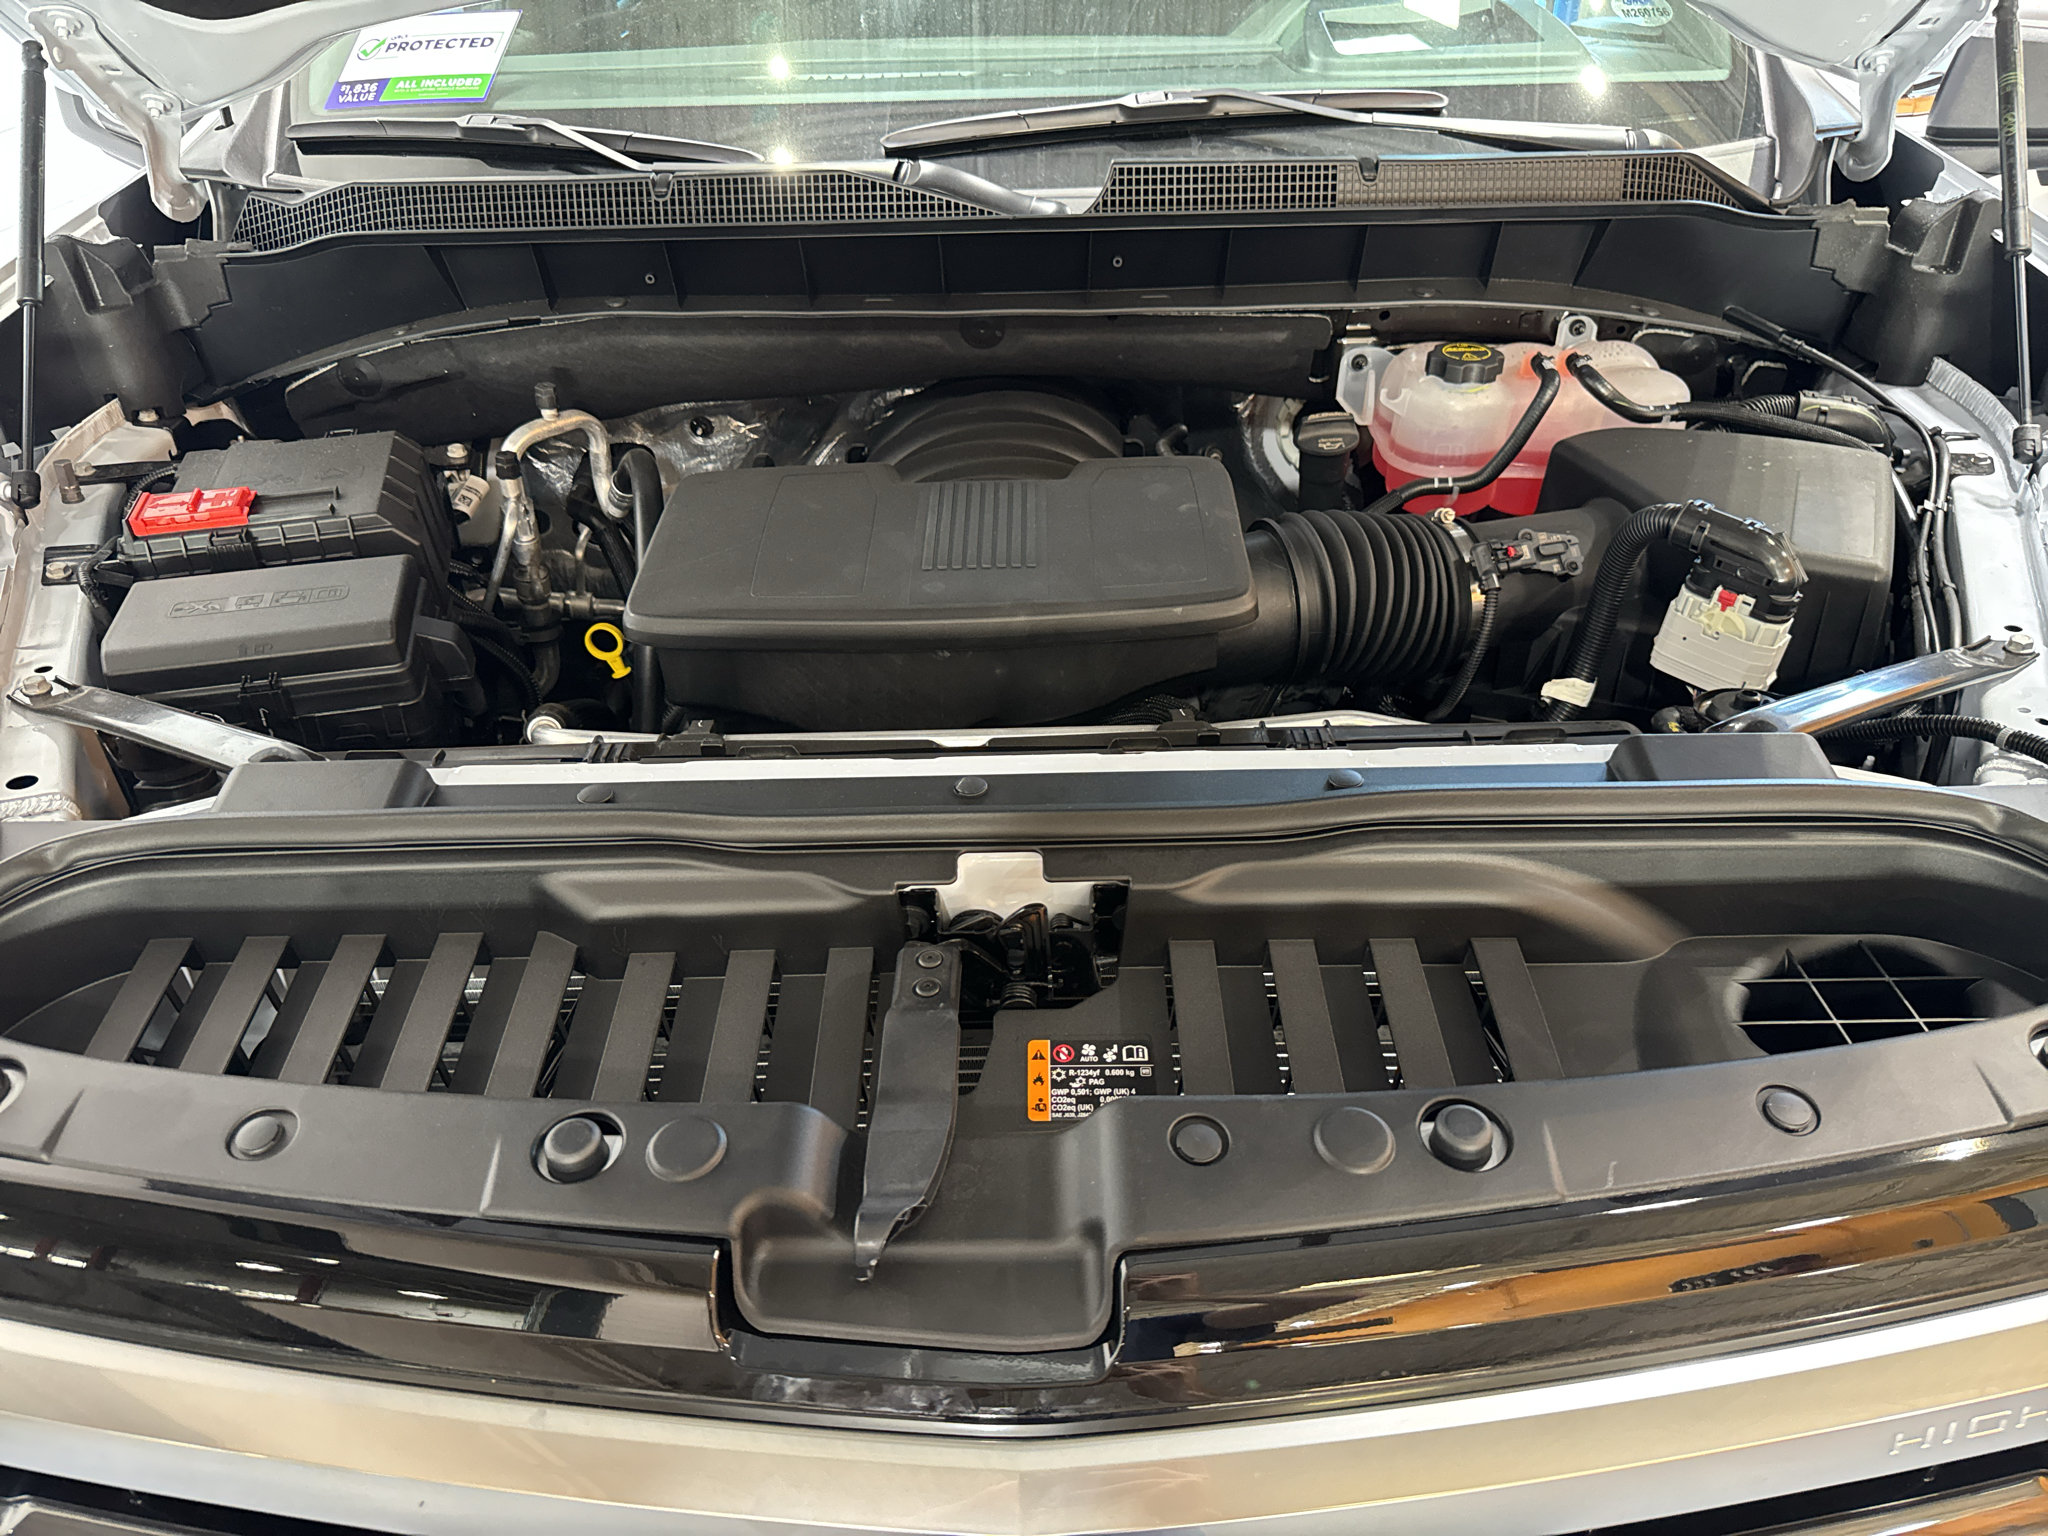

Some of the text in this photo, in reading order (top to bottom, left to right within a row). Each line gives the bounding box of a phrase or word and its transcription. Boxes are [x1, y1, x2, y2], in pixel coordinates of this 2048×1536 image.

[385, 36, 494, 53] PROTECTED
[396, 77, 482, 89] ALL INCLUDED
[340, 82, 379, 94] $1,836
[338, 93, 376, 104] VALUE
[1069, 1069, 1100, 1077] R-1234yf
[1125, 1069, 1135, 1077] kg
[1113, 1088, 1130, 1096] (UK)
[1051, 1096, 1076, 1104] CO2eq
[1051, 1104, 1076, 1112] CO2eq
[1077, 1104, 1094, 1112] (UK)
